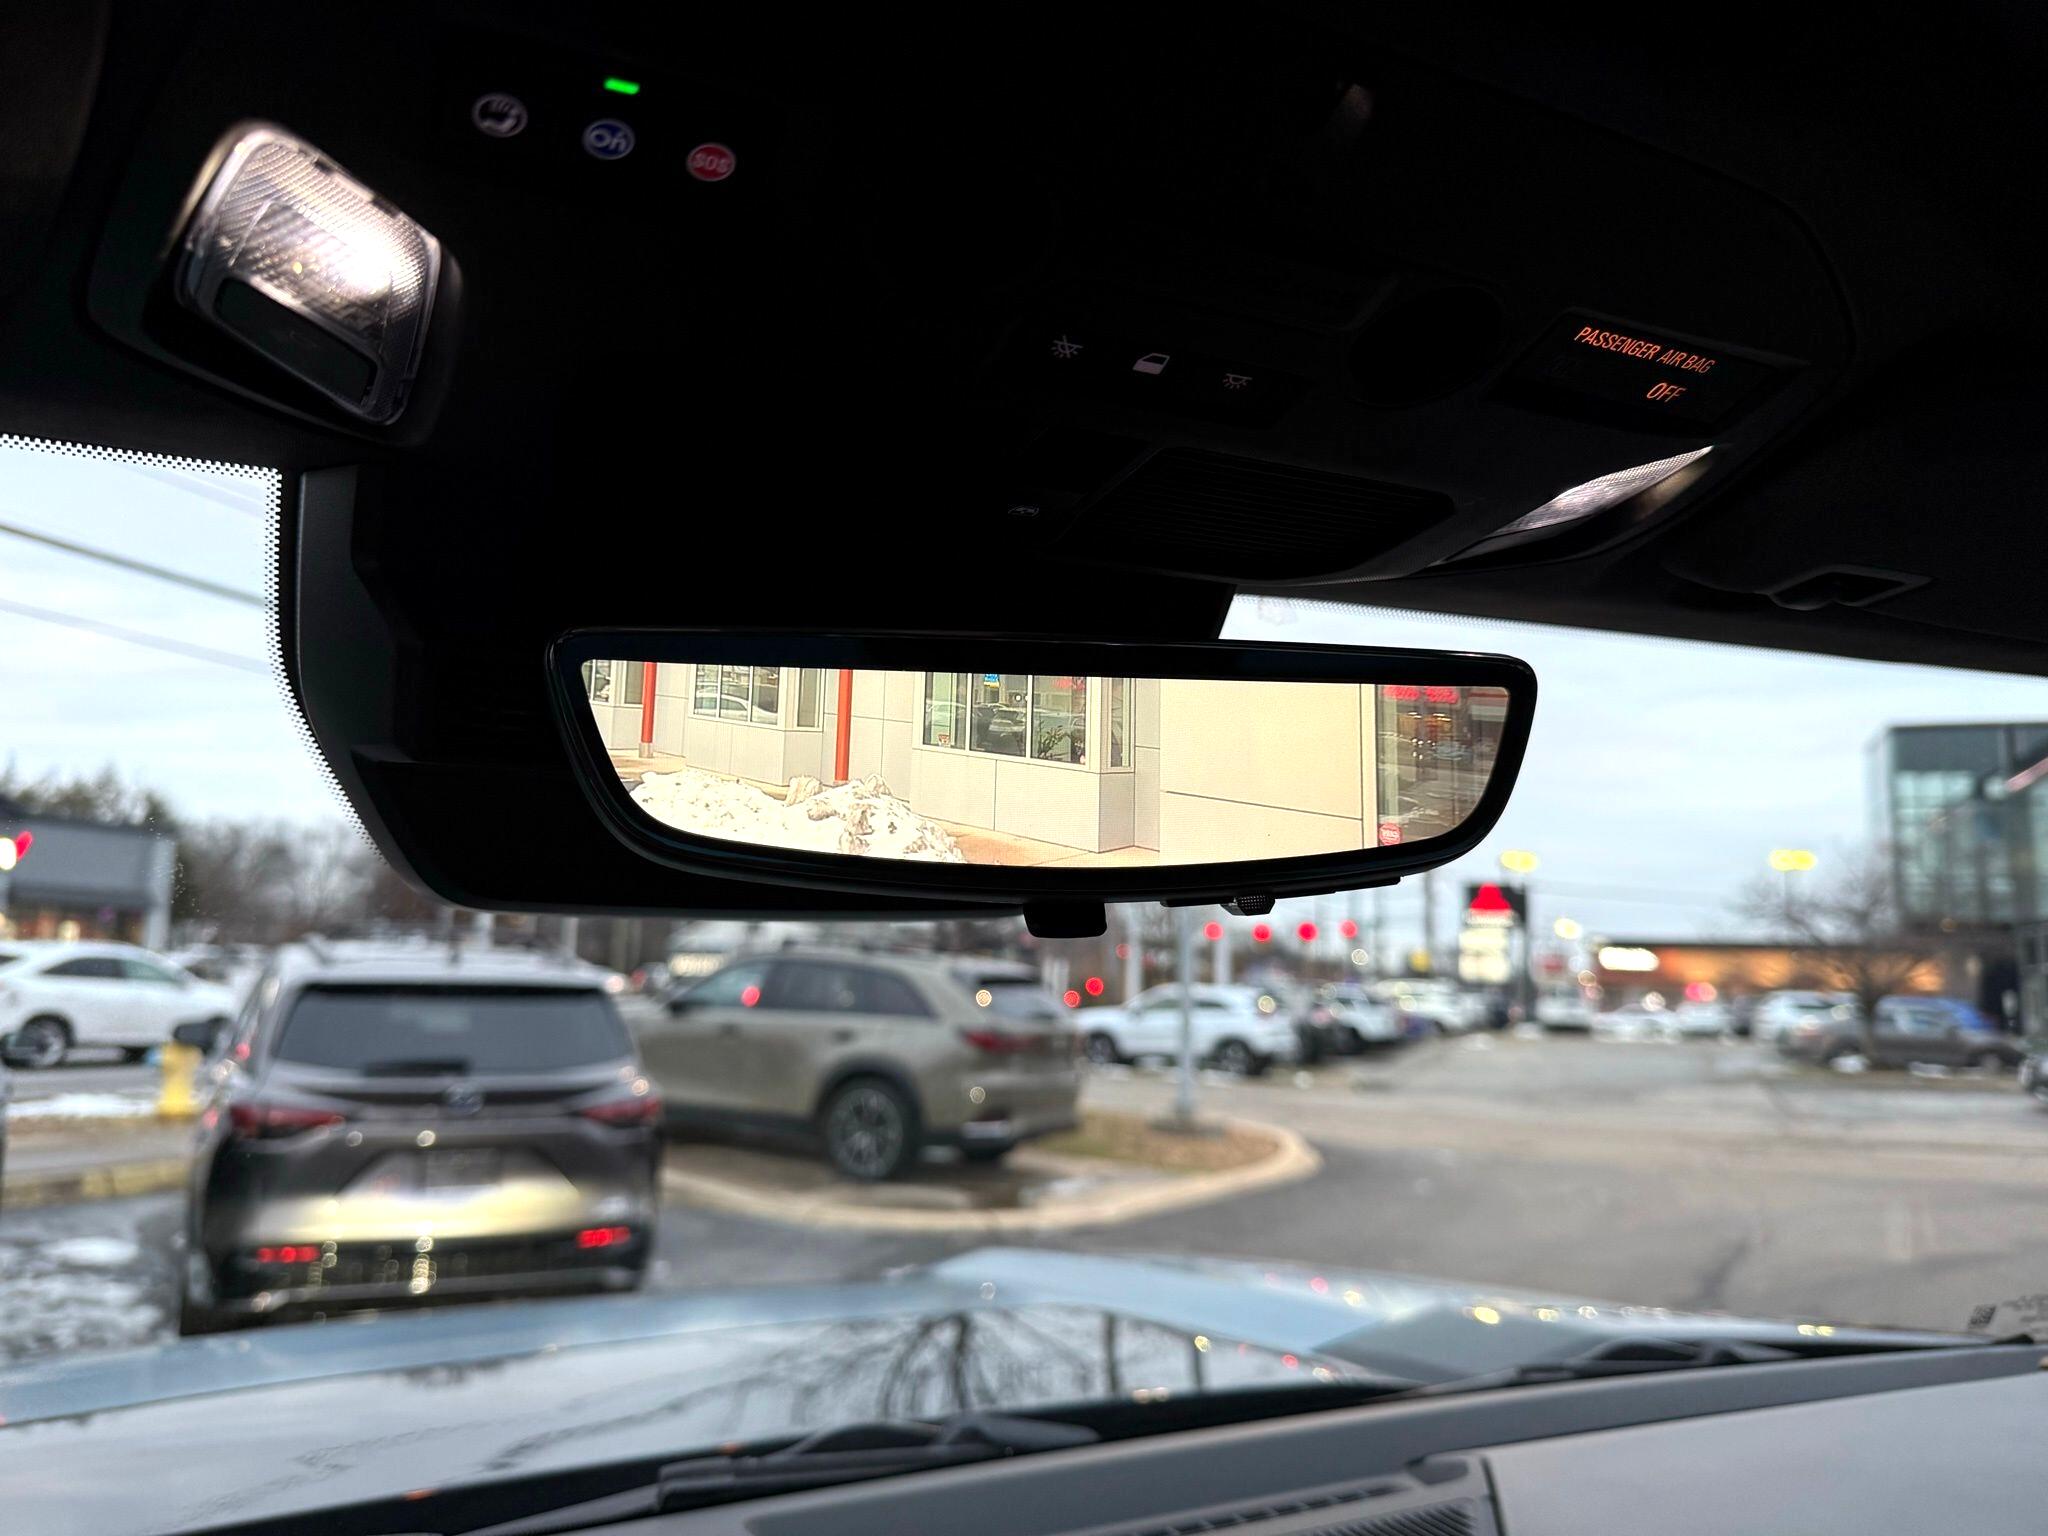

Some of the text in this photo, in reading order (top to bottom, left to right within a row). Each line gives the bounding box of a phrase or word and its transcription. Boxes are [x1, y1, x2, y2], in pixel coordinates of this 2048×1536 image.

[693, 152, 730, 173] SOS
[1574, 326, 1716, 374] PASSENGER AIR BAG
[1646, 382, 1687, 403] OFF
